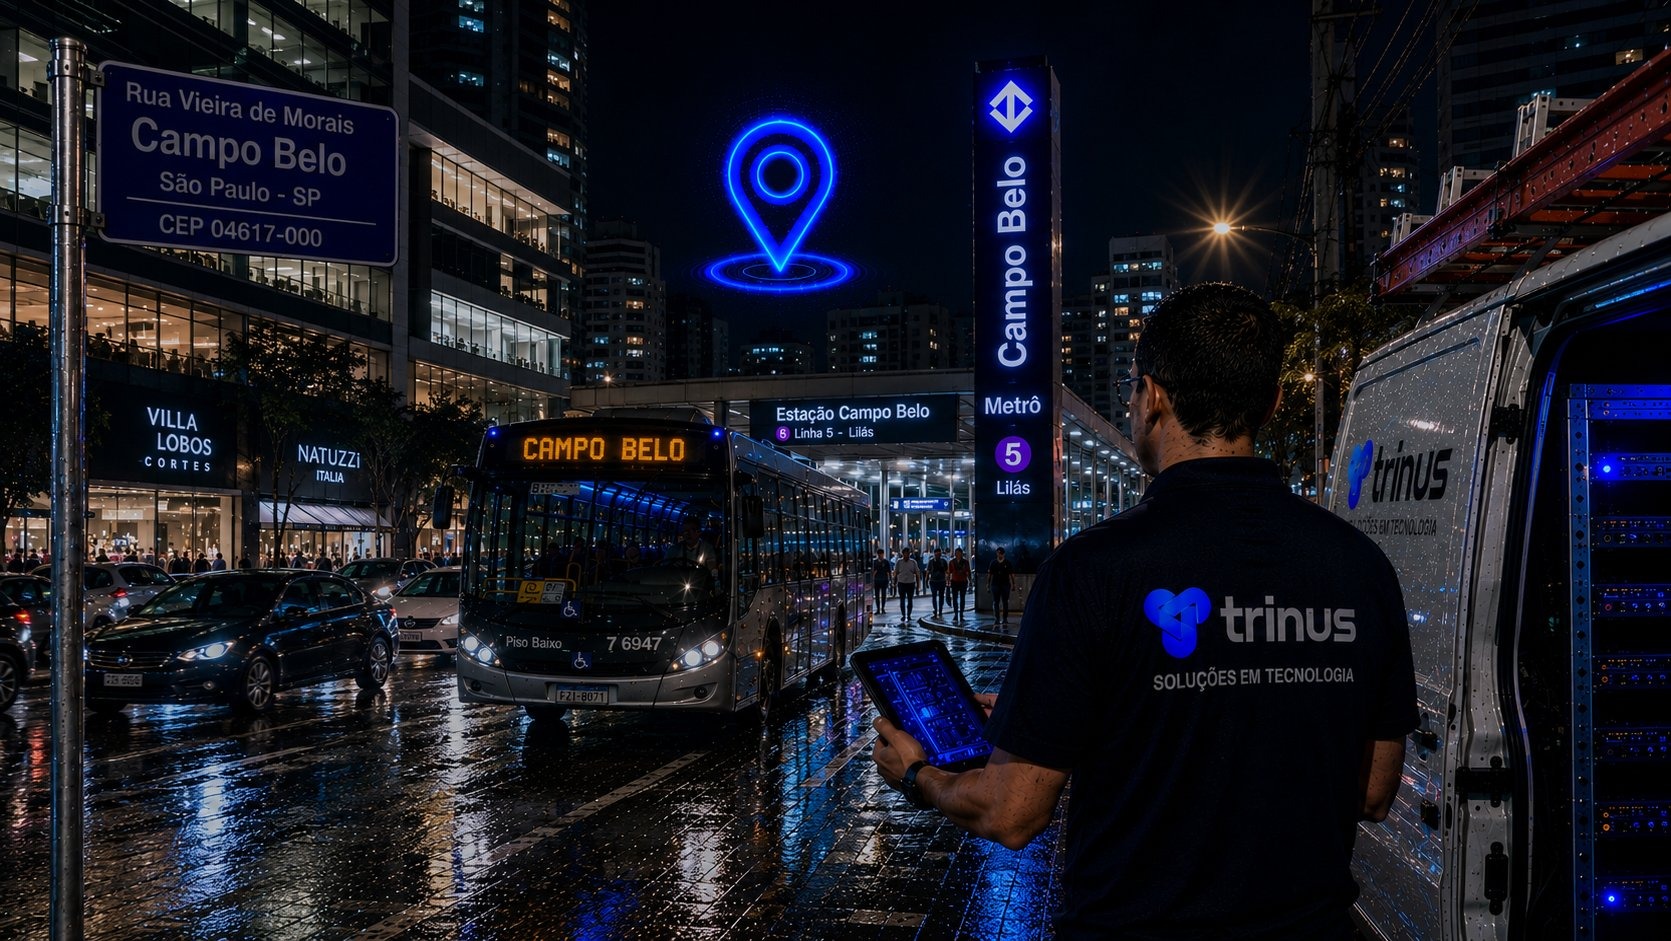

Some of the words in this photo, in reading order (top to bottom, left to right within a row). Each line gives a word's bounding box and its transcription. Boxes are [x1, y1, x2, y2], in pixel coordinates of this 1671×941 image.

[126, 81, 171, 108] Rua
[179, 89, 242, 119] Vieira
[250, 101, 276, 123] de
[284, 106, 354, 135] Morais
[131, 116, 262, 169] Campo
[274, 136, 346, 176] Belo
[159, 171, 202, 195] São
[210, 177, 270, 202] Paulo
[293, 187, 321, 207] SP
[997, 156, 1027, 233] Belo
[159, 214, 204, 236] CEP
[211, 219, 322, 247] 04617-000
[998, 245, 1033, 368] Campo
[776, 406, 835, 424] Estação
[838, 405, 892, 423] Campo
[896, 403, 930, 419] Belo
[984, 396, 1041, 415] Metrô
[146, 406, 198, 432] VILLA
[156, 432, 212, 456] LOBOS
[794, 428, 823, 439] Linha
[826, 427, 834, 438] 5
[848, 426, 874, 438] Lilás
[523, 437, 606, 460] CAMPO
[621, 437, 685, 462] BELO
[1004, 443, 1022, 466] 5
[144, 456, 211, 472] CORTES
[1372, 440, 1453, 503] trinus
[316, 470, 345, 484] ITALIA
[996, 480, 1030, 495] Lilás
[1380, 520, 1391, 535] EM
[1391, 519, 1437, 536] TECNOLOGIA
[1220, 595, 1357, 643] trinus
[506, 635, 529, 649] Piso
[532, 636, 563, 650] Baixo
[606, 636, 617, 651] 7
[621, 636, 663, 651] 6947
[1153, 666, 1237, 692] SOLUÇÕES
[1240, 668, 1261, 685] EM
[1265, 667, 1354, 684] TECNOLOGIA
